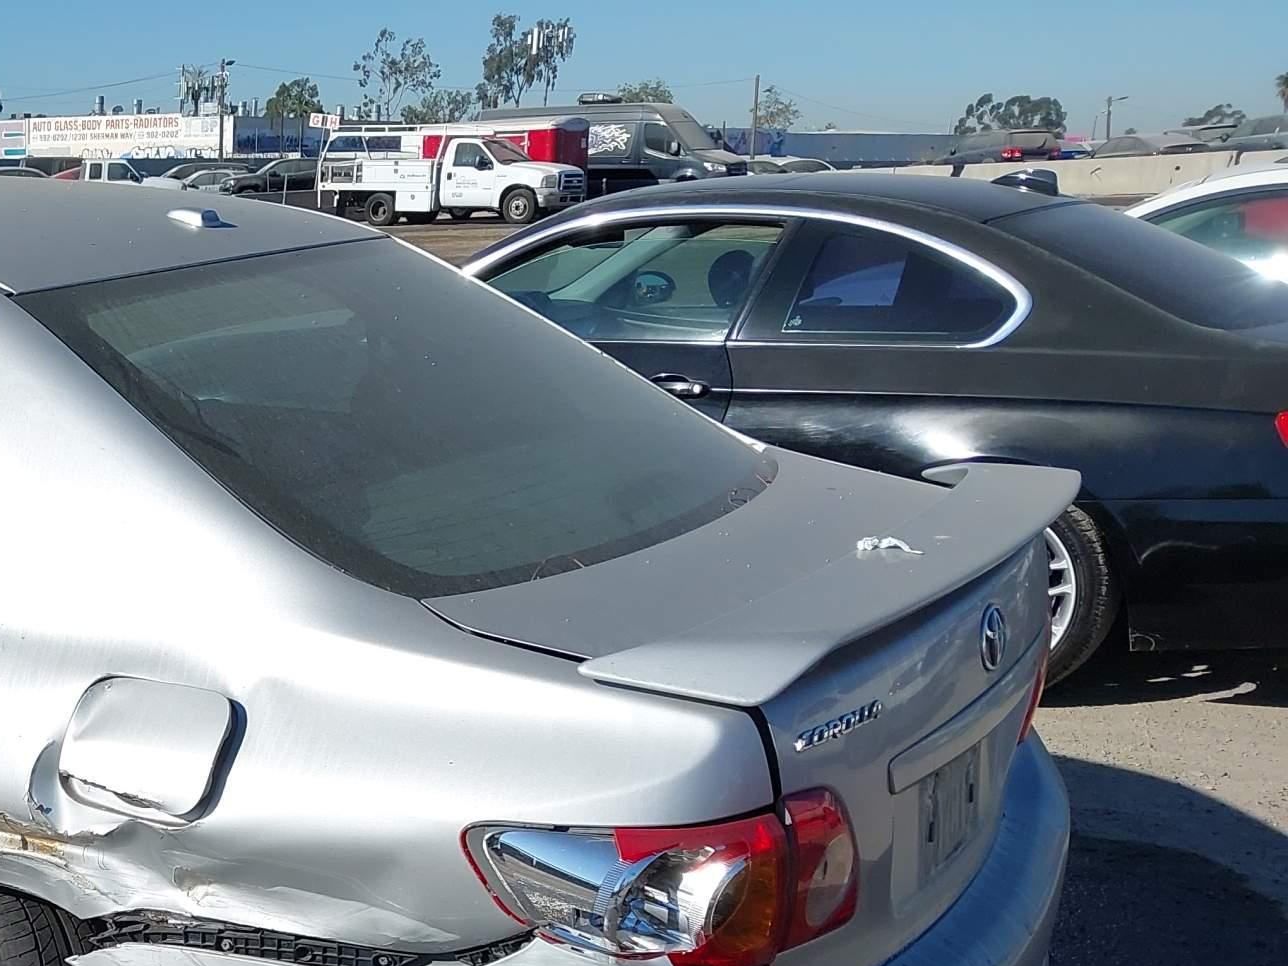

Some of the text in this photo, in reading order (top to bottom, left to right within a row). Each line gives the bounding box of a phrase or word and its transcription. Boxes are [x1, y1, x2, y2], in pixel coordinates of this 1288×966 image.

[32, 121, 52, 132] AUTO
[89, 132, 118, 141] SHERMAN
[793, 699, 882, 752] COROLLA
